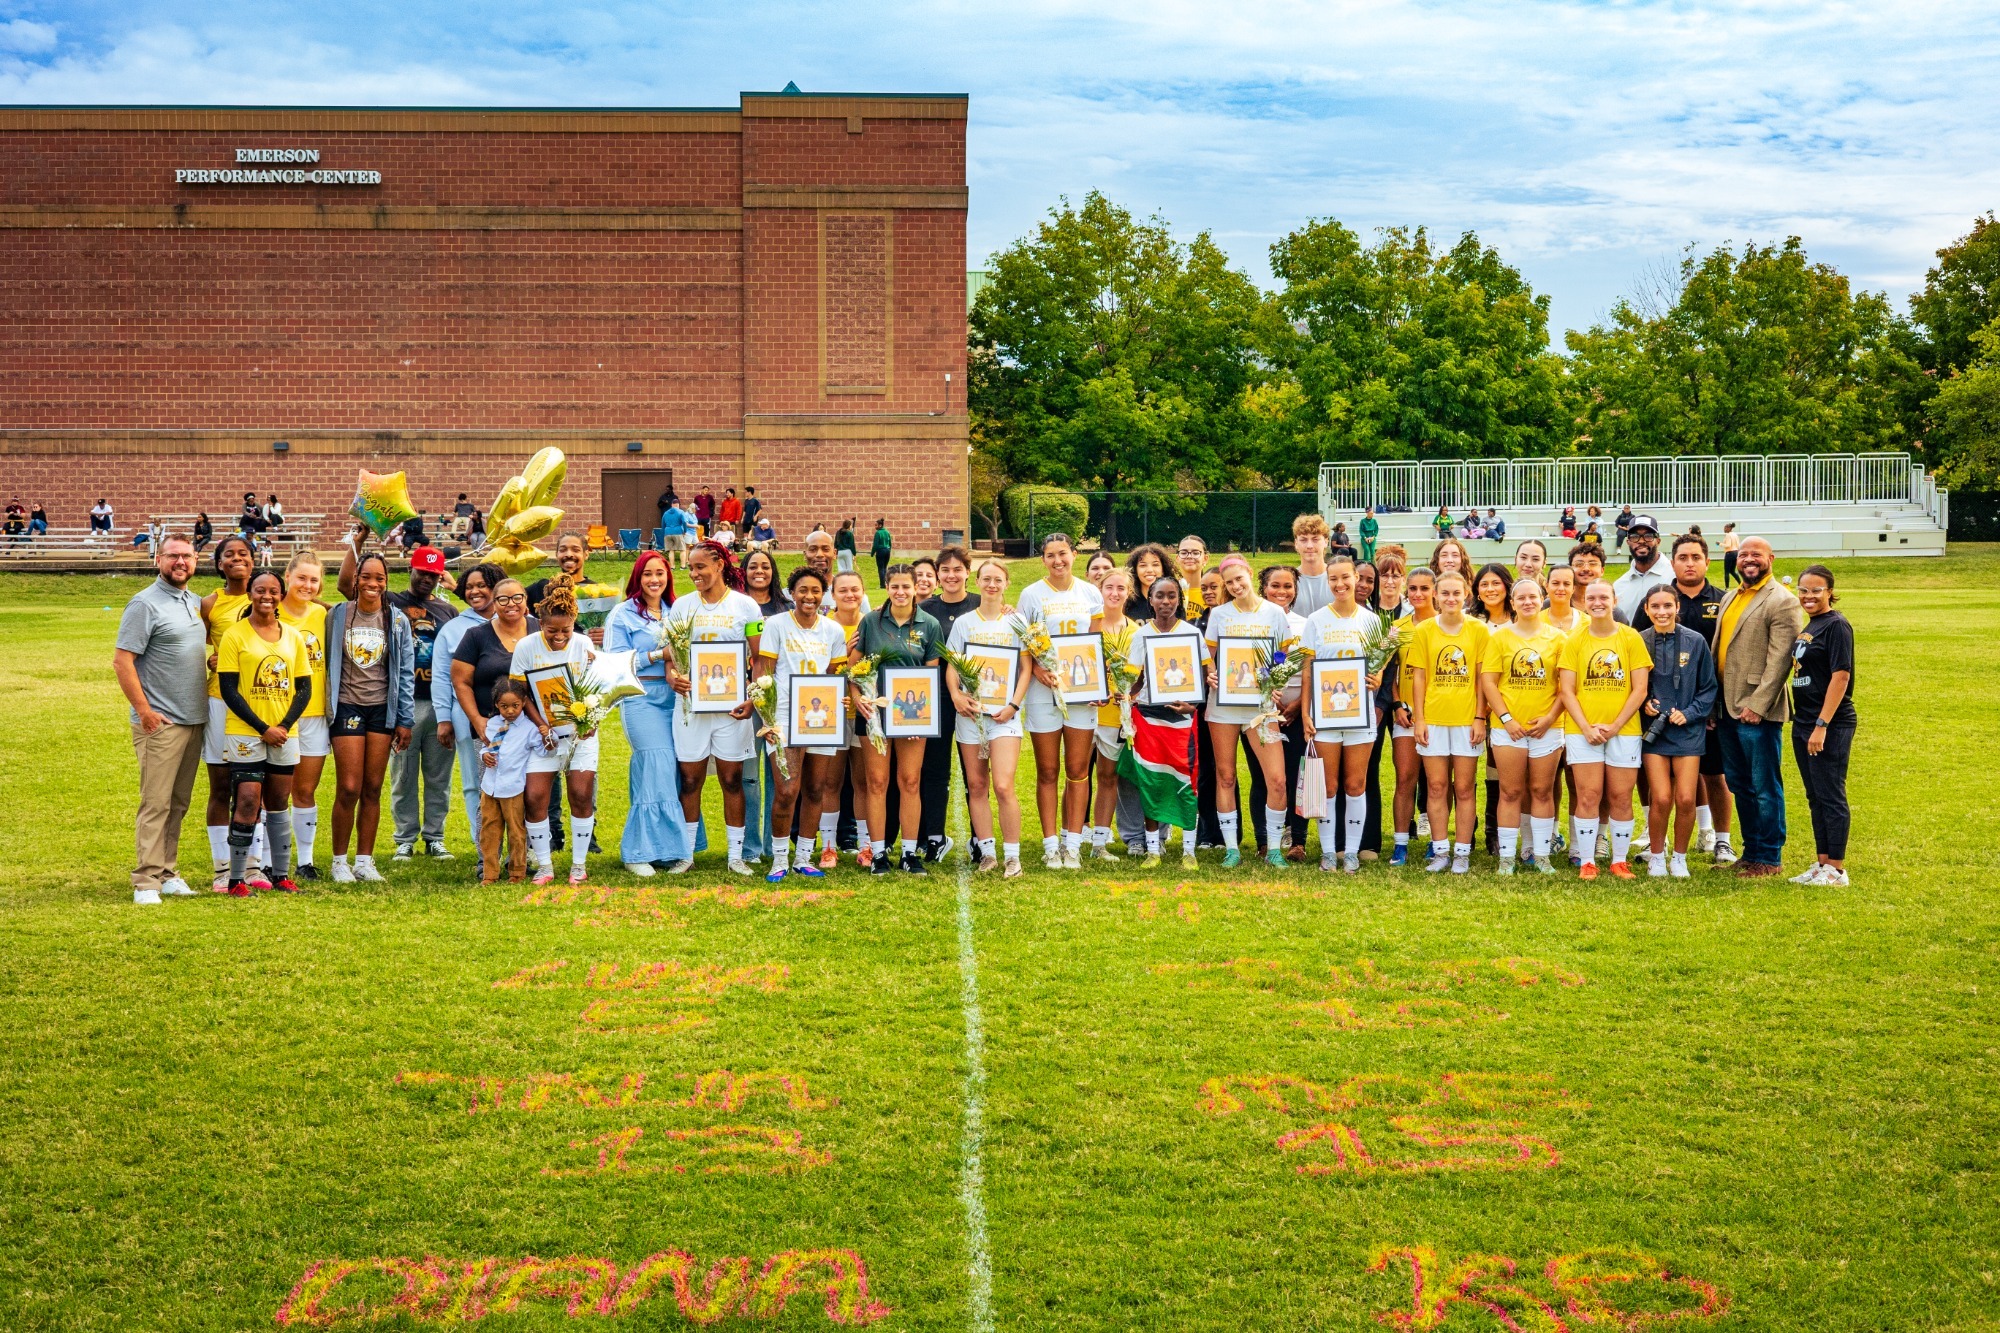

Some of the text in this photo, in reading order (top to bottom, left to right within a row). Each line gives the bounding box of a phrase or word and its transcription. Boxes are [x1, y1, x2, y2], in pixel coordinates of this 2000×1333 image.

[235, 148, 319, 163] EMERSON
[175, 169, 381, 184] PERFORMANCE CENTER
[360, 482, 402, 519] Congrats!
[426, 554, 437, 563] W
[689, 614, 734, 629] RRIS-STOWE
[757, 622, 763, 632] C
[1059, 619, 1077, 634] 16
[1225, 624, 1271, 636] HARRIS-STOWE
[799, 659, 817, 675] 19
[1508, 678, 1547, 686] HARRIS-STOWE
[1583, 679, 1626, 687] HARRIS-STOWE
[1276, 1114, 1561, 1177] 15
[274, 1245, 893, 1328] DIANA
